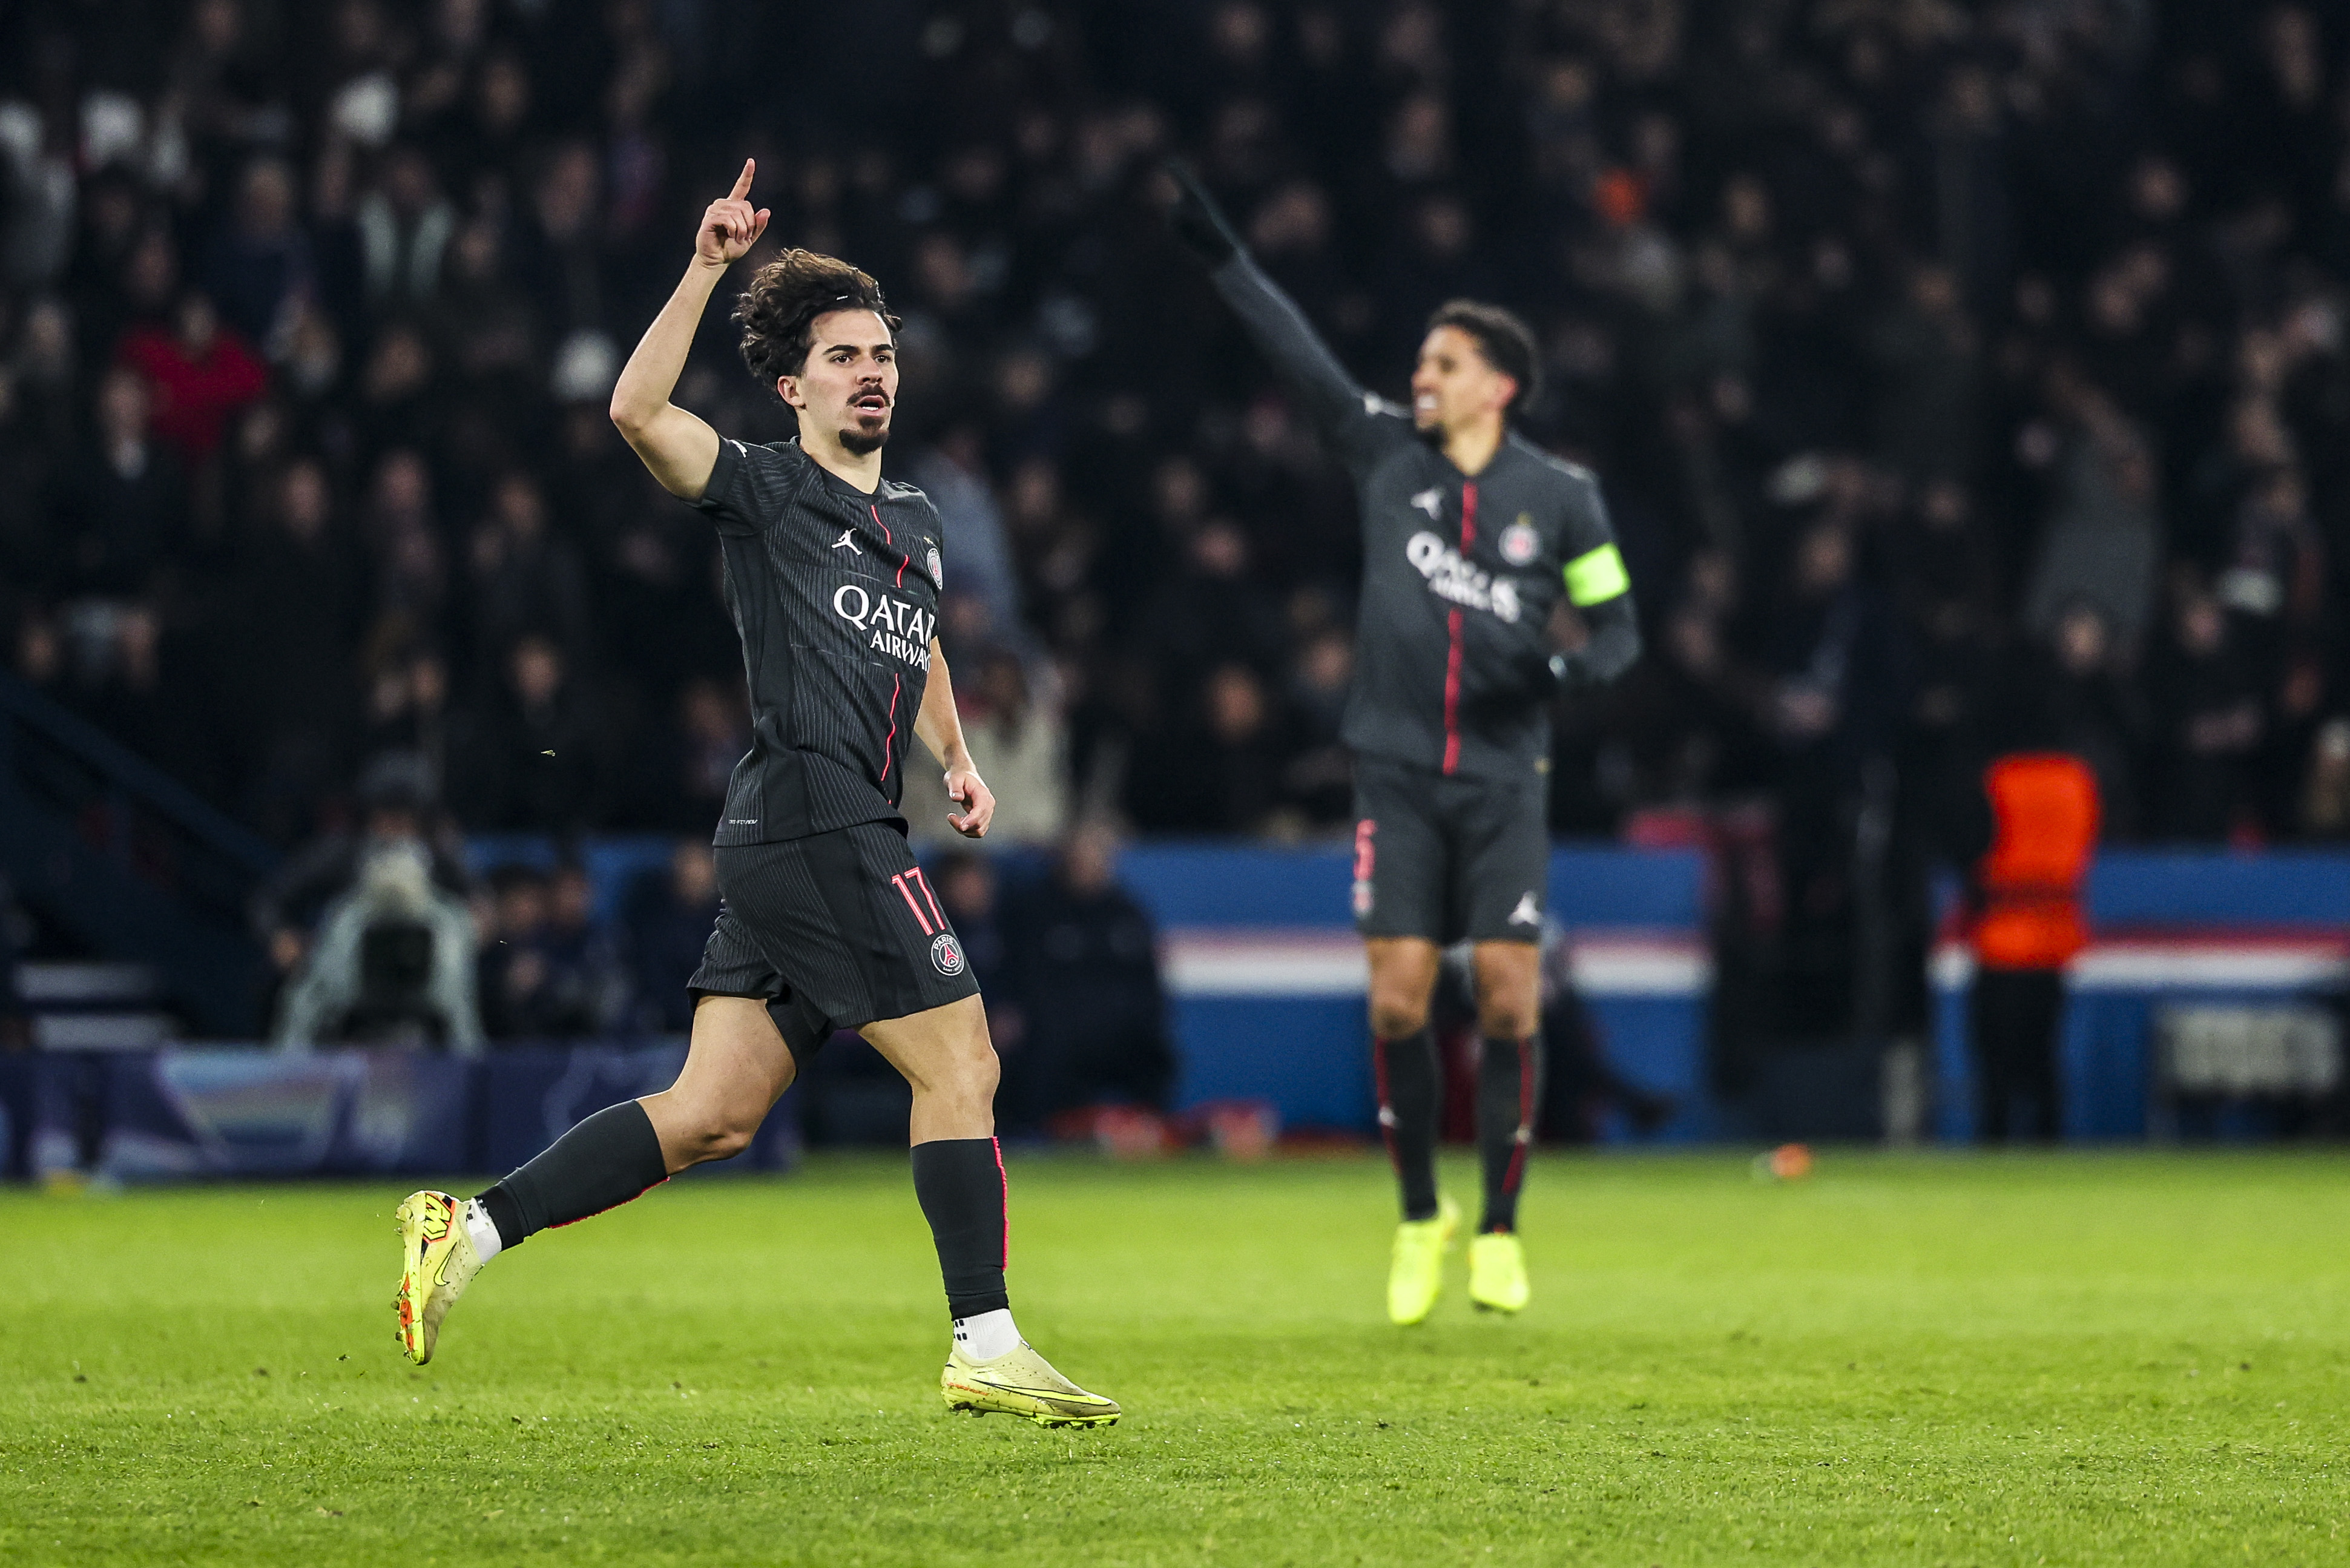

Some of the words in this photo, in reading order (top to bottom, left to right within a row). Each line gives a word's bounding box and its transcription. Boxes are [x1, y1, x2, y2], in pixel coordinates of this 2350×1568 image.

[870, 630, 931, 674] AIRWAY
[892, 866, 946, 935] 17
[934, 936, 953, 950] PARIS
